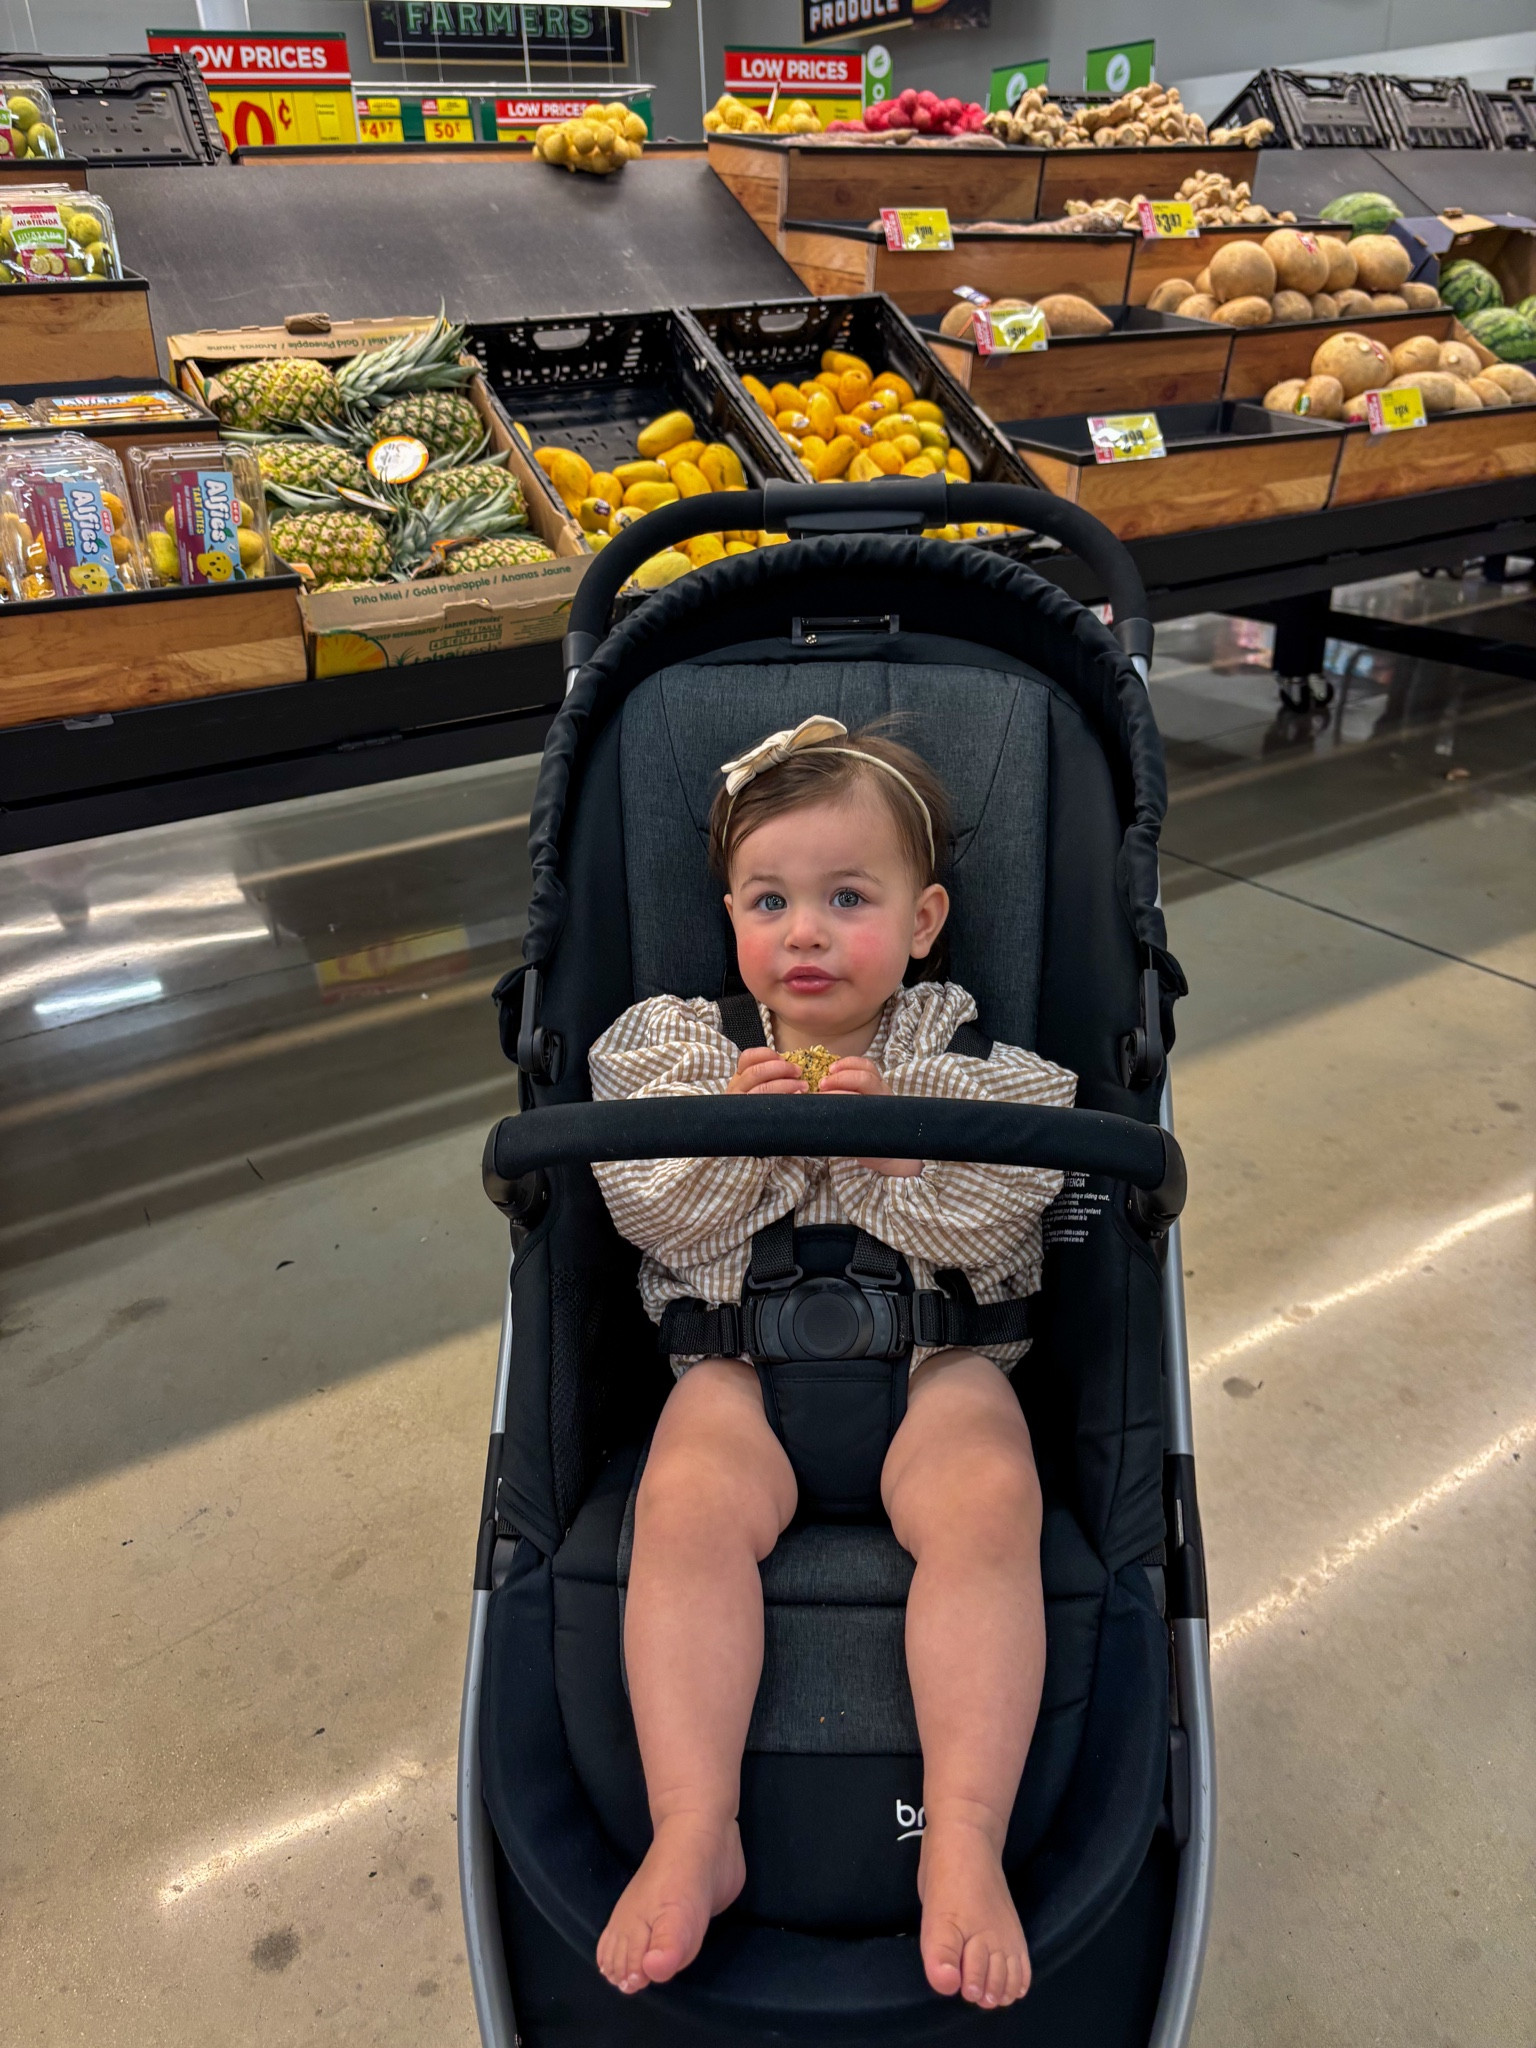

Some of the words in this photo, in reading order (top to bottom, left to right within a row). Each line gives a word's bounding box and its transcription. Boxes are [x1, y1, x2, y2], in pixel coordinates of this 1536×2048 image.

[406, 2, 594, 38] FARMERS
[809, 0, 900, 33] PRODUCE
[240, 46, 328, 69] PRICES
[741, 58, 784, 79] LOW
[787, 60, 848, 81] PRICES
[507, 102, 541, 118] LOW
[32, 217, 59, 226] TIENDA
[288, 339, 336, 350] Pineapple
[58, 498, 71, 520] TART
[191, 486, 203, 508] TART
[71, 489, 101, 555] Alfies
[194, 509, 205, 535] BITES
[204, 479, 230, 542] Alfies
[63, 520, 75, 547] BITES
[353, 592, 378, 606] Piña
[379, 590, 403, 603] Miel
[413, 584, 438, 598] Gold
[439, 576, 491, 594] Pineapple
[501, 570, 539, 584] Ananas
[540, 564, 572, 578] Jaune
[896, 1799, 925, 1827] br
